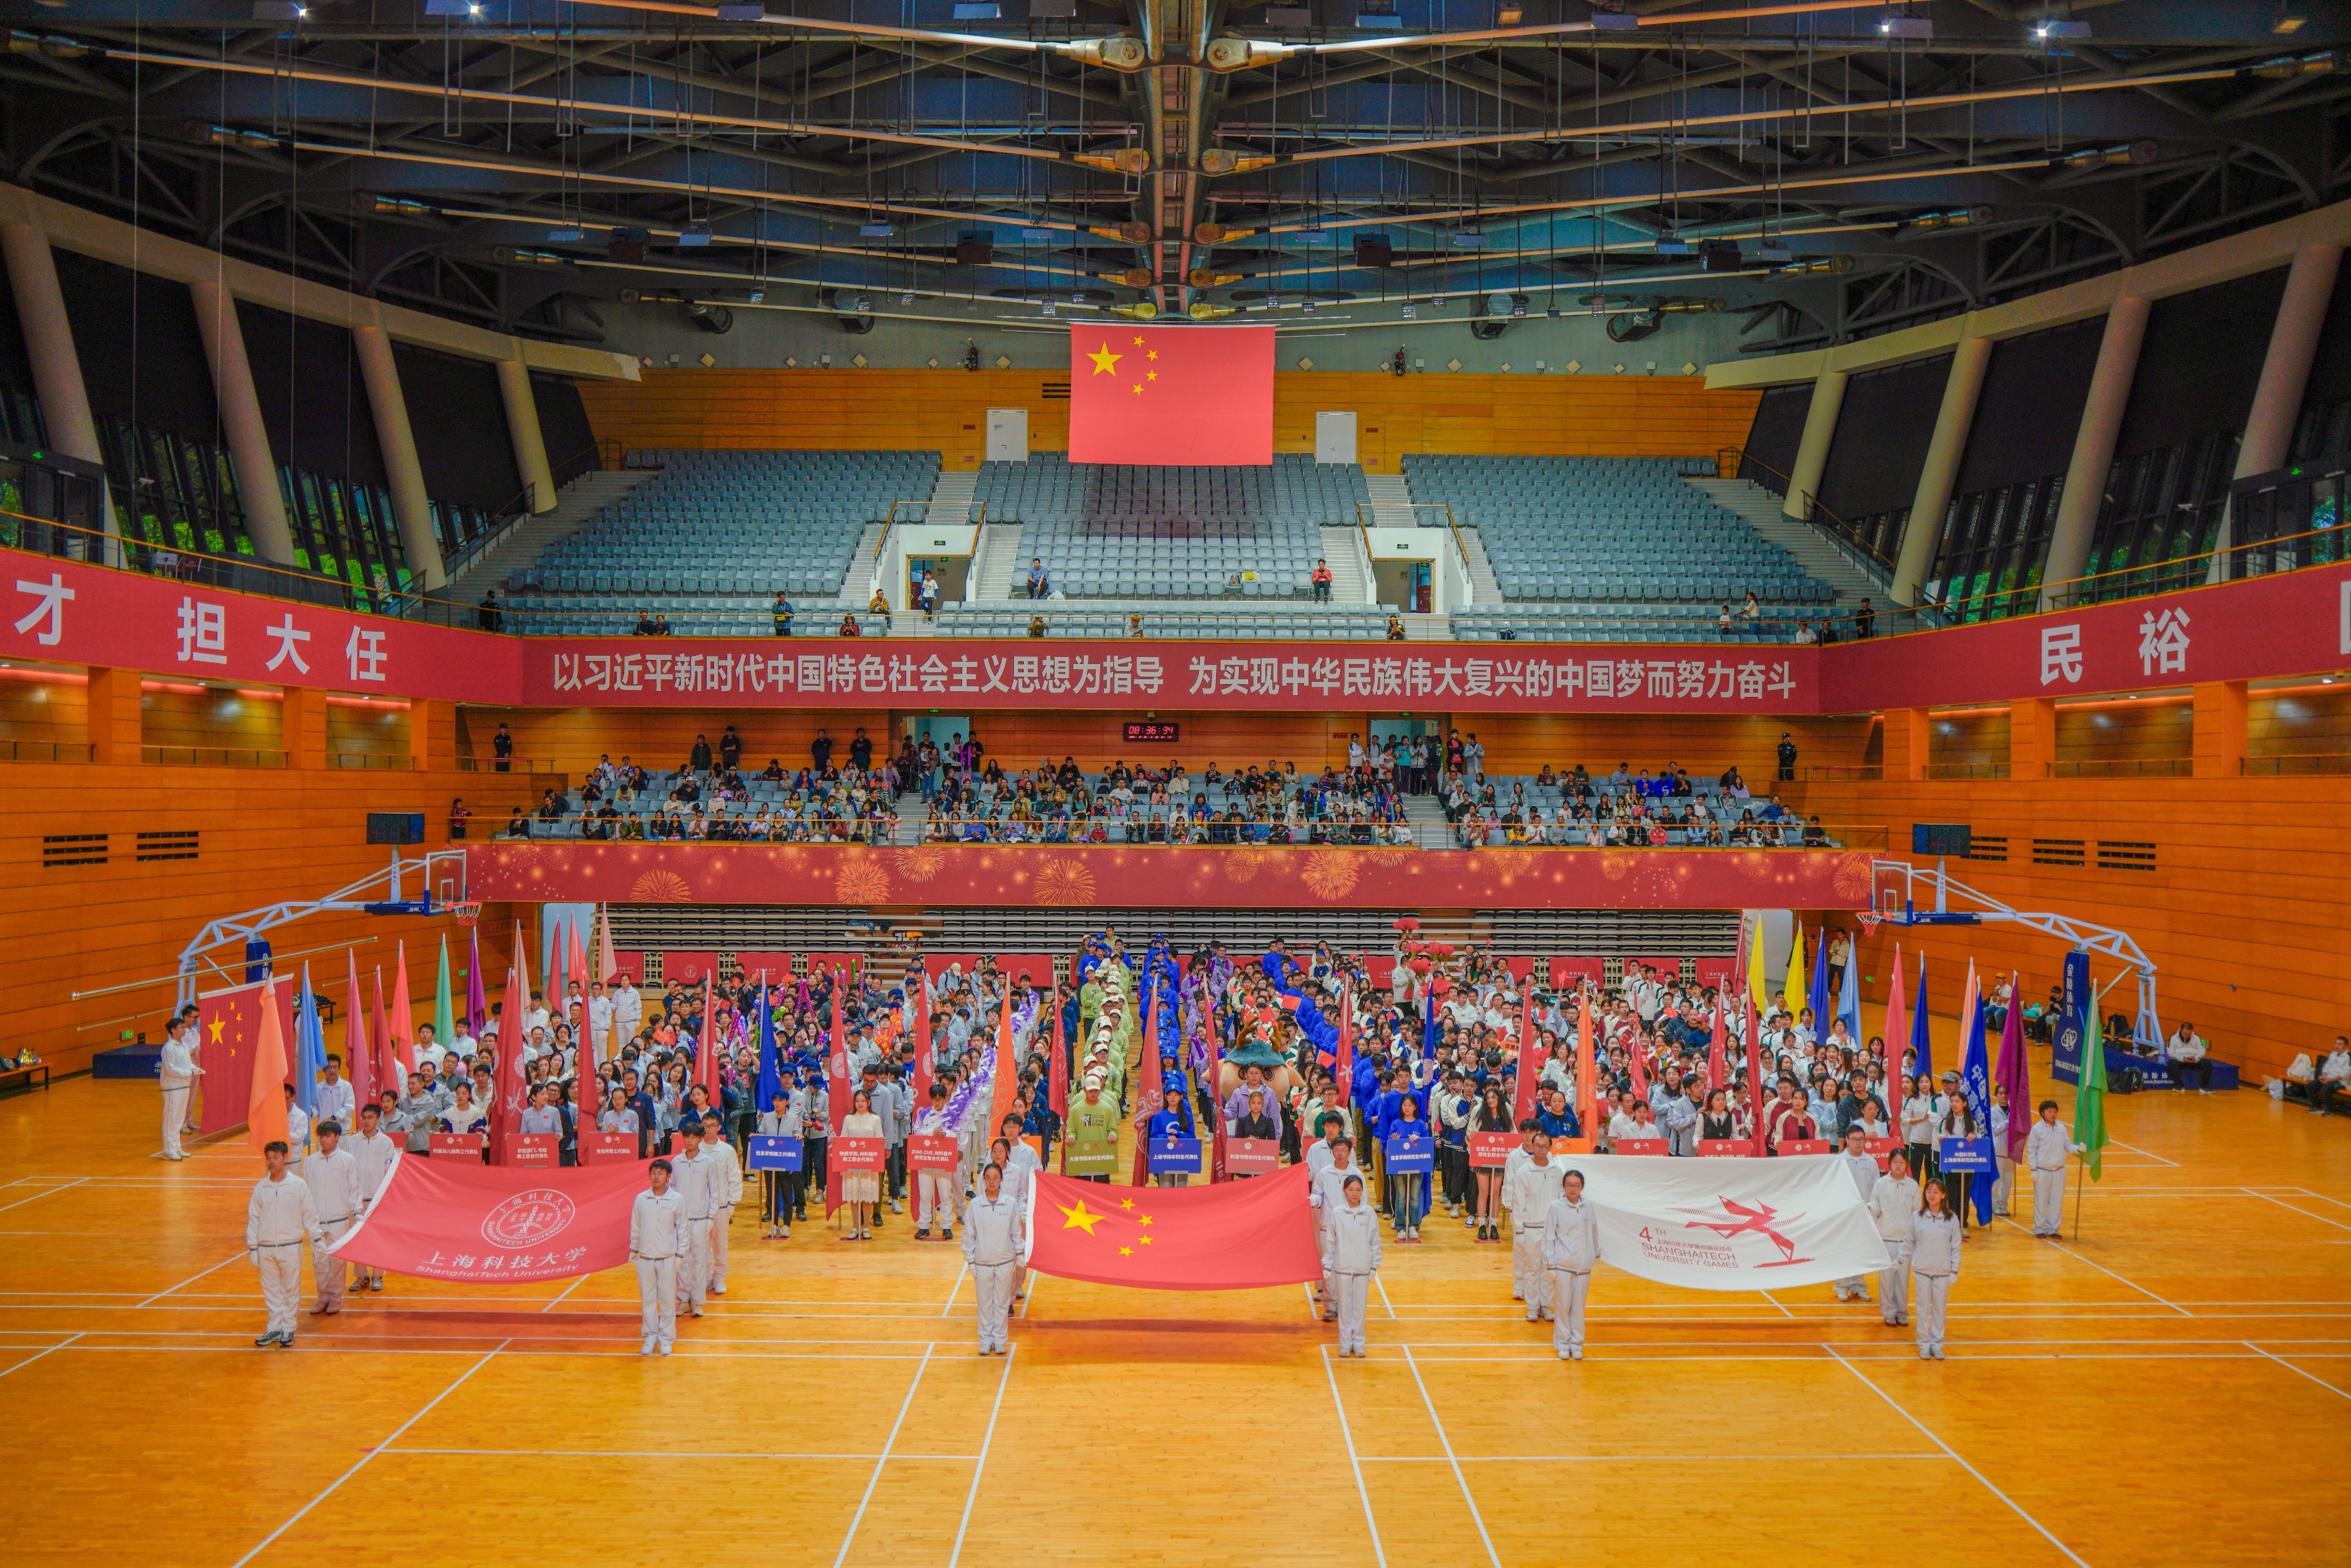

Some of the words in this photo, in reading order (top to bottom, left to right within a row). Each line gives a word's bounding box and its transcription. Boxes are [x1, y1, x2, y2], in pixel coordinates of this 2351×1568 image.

[15, 573, 75, 646] 才
[553, 652, 1164, 695] 以习近平新时代中国特色社会主义思想为指导
[1188, 655, 1797, 699] 为实现中华民族伟大复兴的中国梦而努力奋斗
[500, 1192, 571, 1214] 上海科技大学
[487, 1221, 523, 1245] SHANGHAITECH
[525, 1219, 567, 1244] UNIVERSITY
[1639, 1226, 1653, 1242] 4
[1654, 1228, 1666, 1236] TH
[1642, 1242, 1736, 1261] SHANGHAITECH
[1657, 1238, 1733, 1252] 上海科技大学第四届运动会
[422, 1247, 587, 1269] 上海科技大学
[1643, 1251, 1700, 1265] UNIVERSITY
[1703, 1261, 1739, 1269] GAMES
[416, 1265, 509, 1278] ShanghaiTech
[514, 1264, 579, 1278] University
